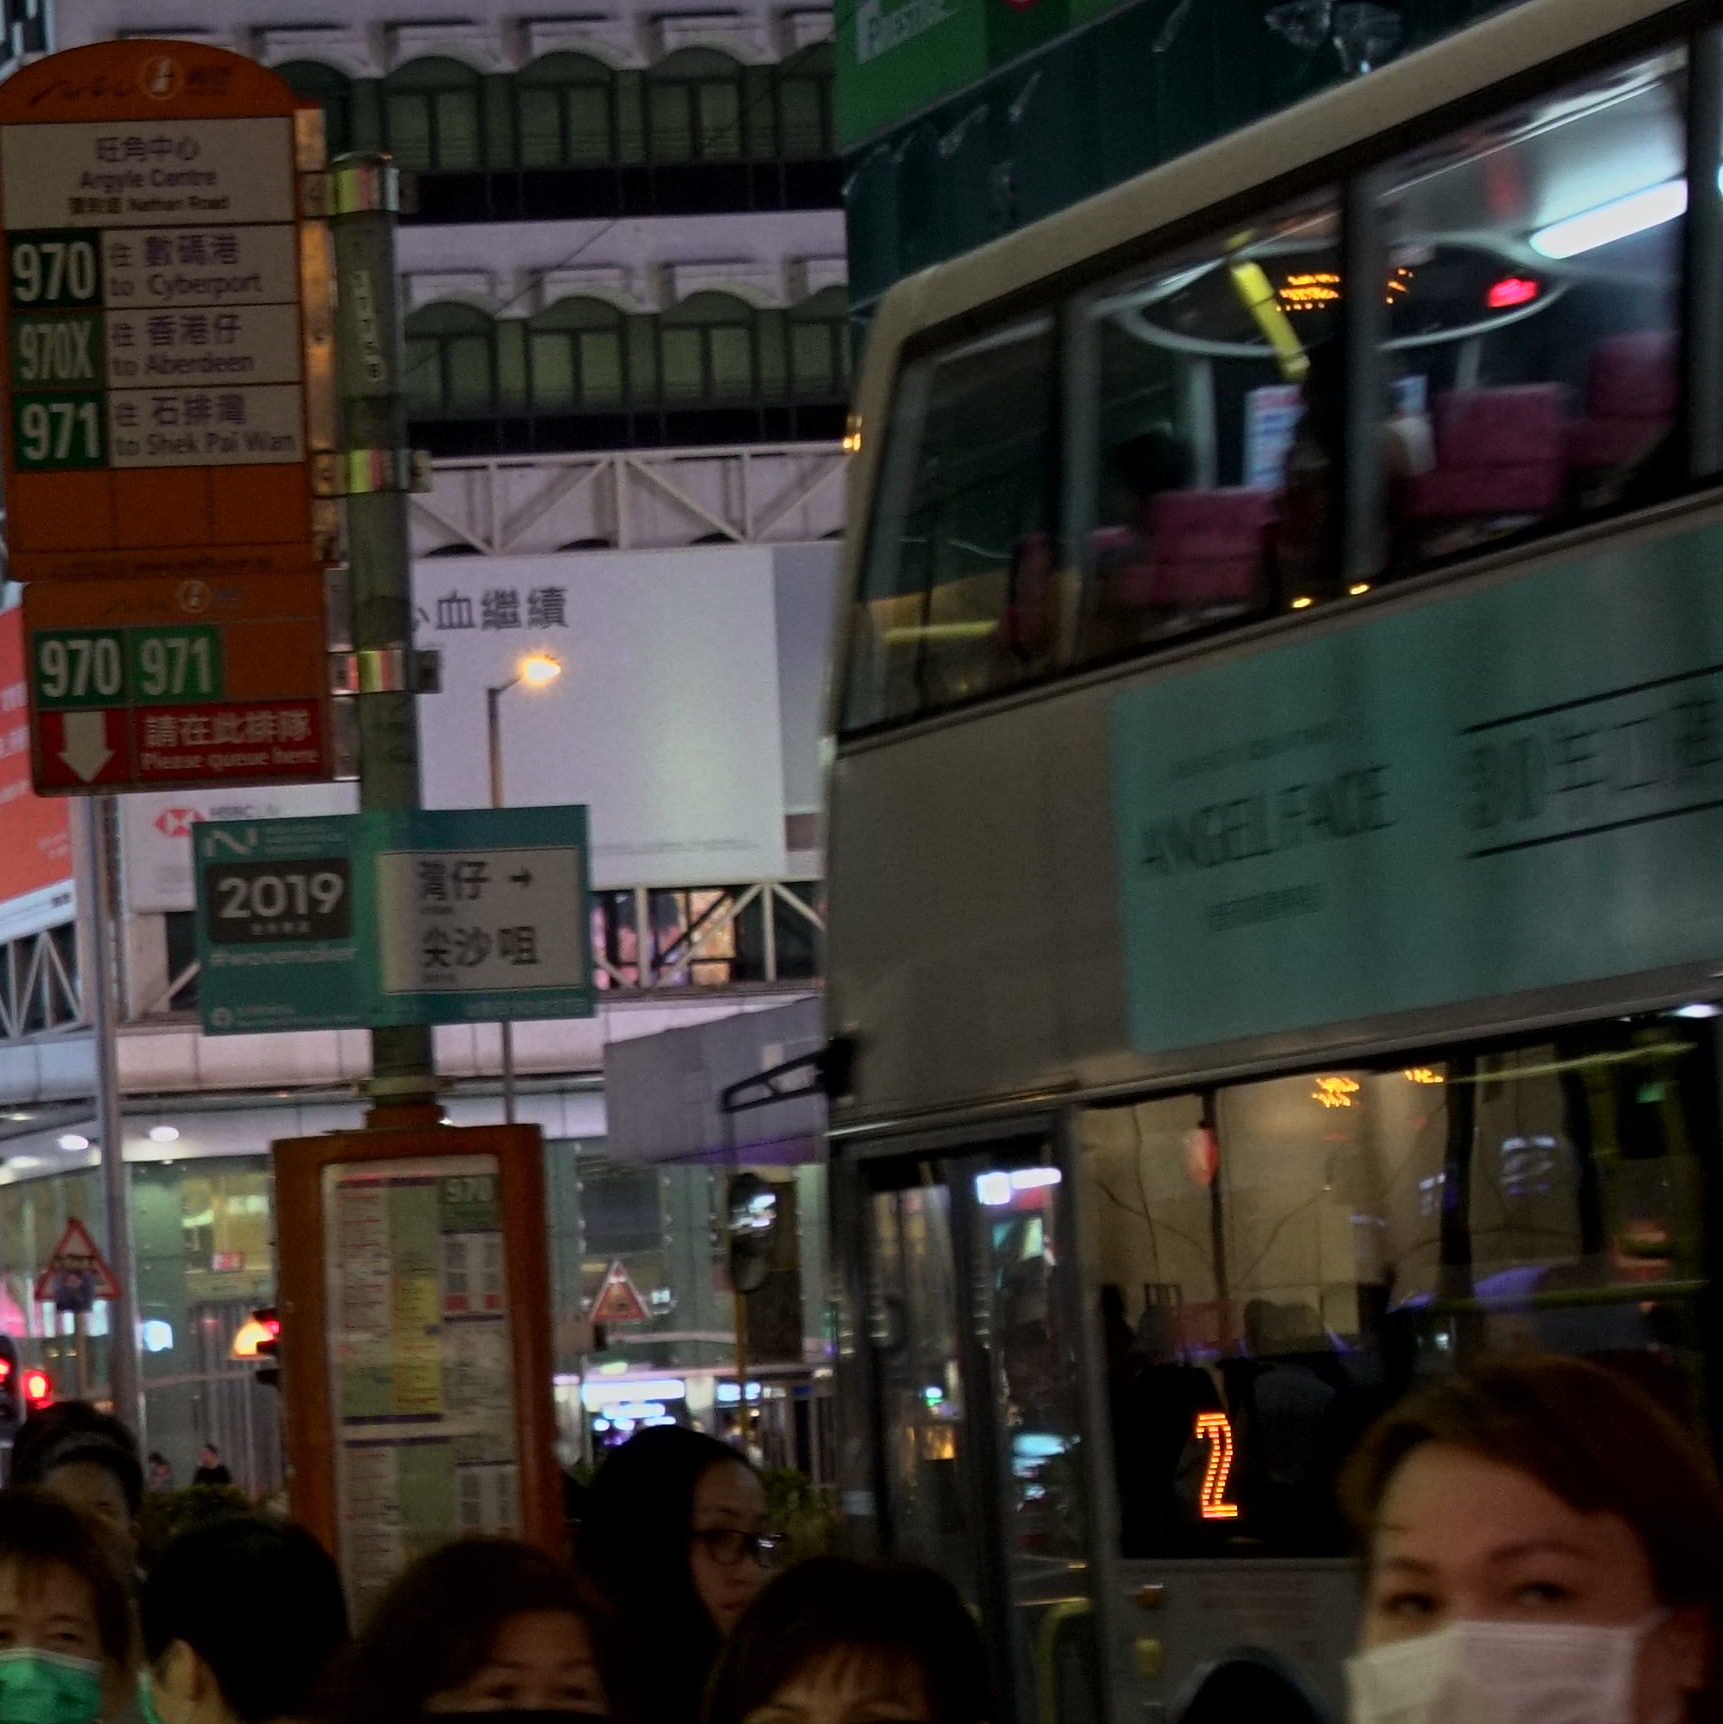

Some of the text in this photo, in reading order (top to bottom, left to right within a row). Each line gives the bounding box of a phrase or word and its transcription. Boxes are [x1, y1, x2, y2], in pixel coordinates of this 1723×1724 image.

[96, 136, 200, 161] 旺角中心
[80, 169, 218, 193] Argyle Centre
[12, 241, 97, 301] 970
[110, 274, 262, 301] to Cyberport
[147, 314, 241, 346] 香港仔
[18, 320, 95, 381] 970X
[112, 353, 255, 375] to Aberdeen
[20, 401, 102, 461] 971
[115, 437, 139, 456] to
[147, 433, 198, 453] Shek
[245, 431, 297, 451] Wan
[40, 637, 213, 698] 970 971
[143, 708, 312, 748] 請在此排隊
[140, 752, 205, 771] Please
[207, 751, 269, 773] queue
[216, 872, 345, 920] 2019
[420, 861, 491, 902] 灣仔
[423, 925, 540, 968] 尖沙咀
[1196, 1411, 1237, 1520] 2
